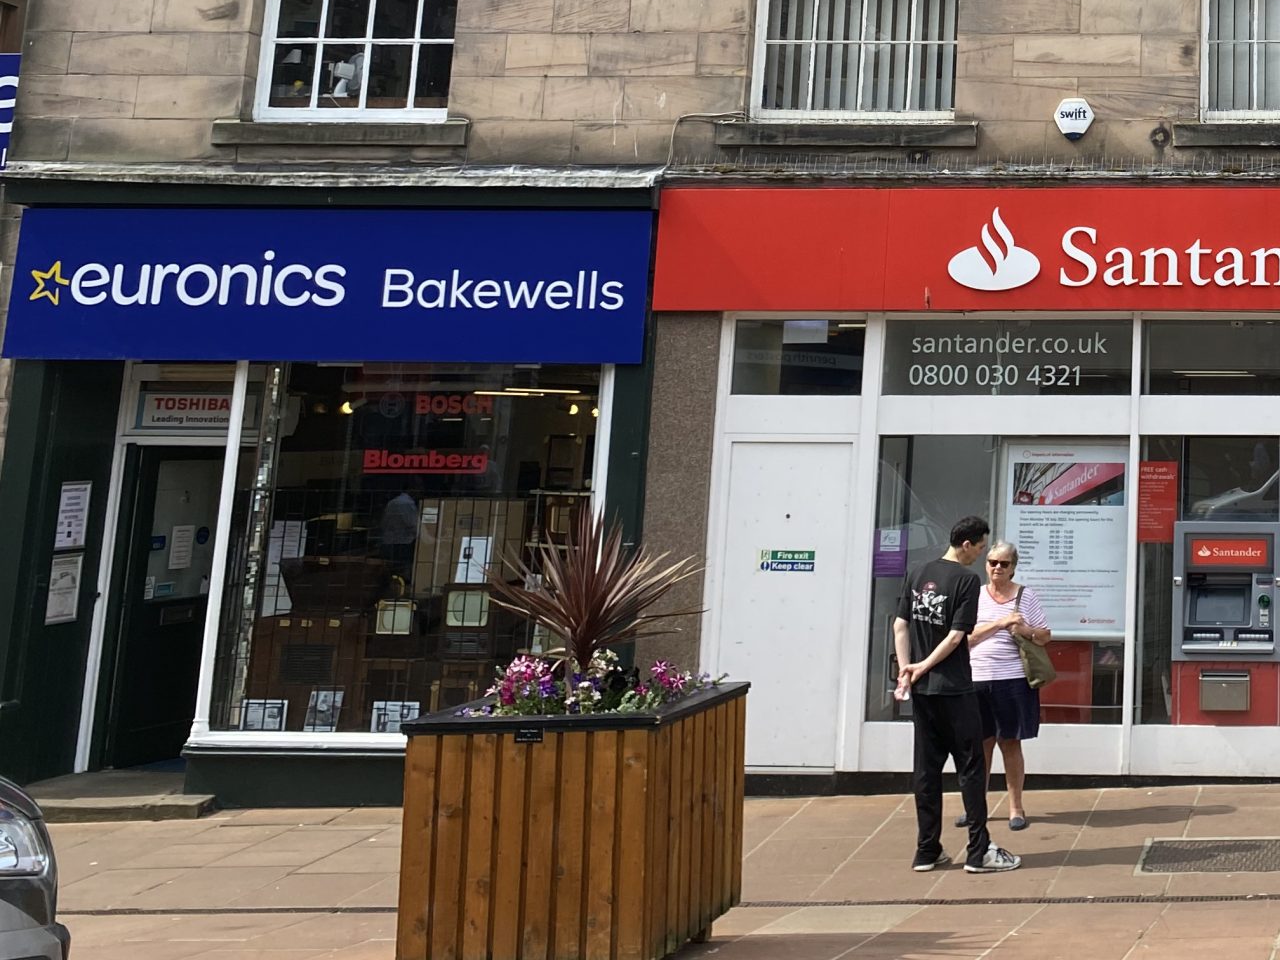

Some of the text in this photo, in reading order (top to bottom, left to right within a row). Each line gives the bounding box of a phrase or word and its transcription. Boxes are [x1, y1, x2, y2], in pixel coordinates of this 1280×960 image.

[1060, 107, 1087, 120] swift
[70, 250, 625, 310] euronics Bakewells
[911, 331, 1108, 354] santander.co.uk
[908, 364, 1082, 386] 0800 030 4321
[154, 397, 231, 411] TOSHIBA
[415, 395, 494, 415] BOSCH
[152, 415, 230, 424] Leading Innovation
[363, 449, 489, 474] Blomberg
[1054, 463, 1100, 498] Santander
[777, 551, 809, 560] Fire exit
[1213, 547, 1262, 557] Santander
[771, 562, 813, 571] Keep clear
